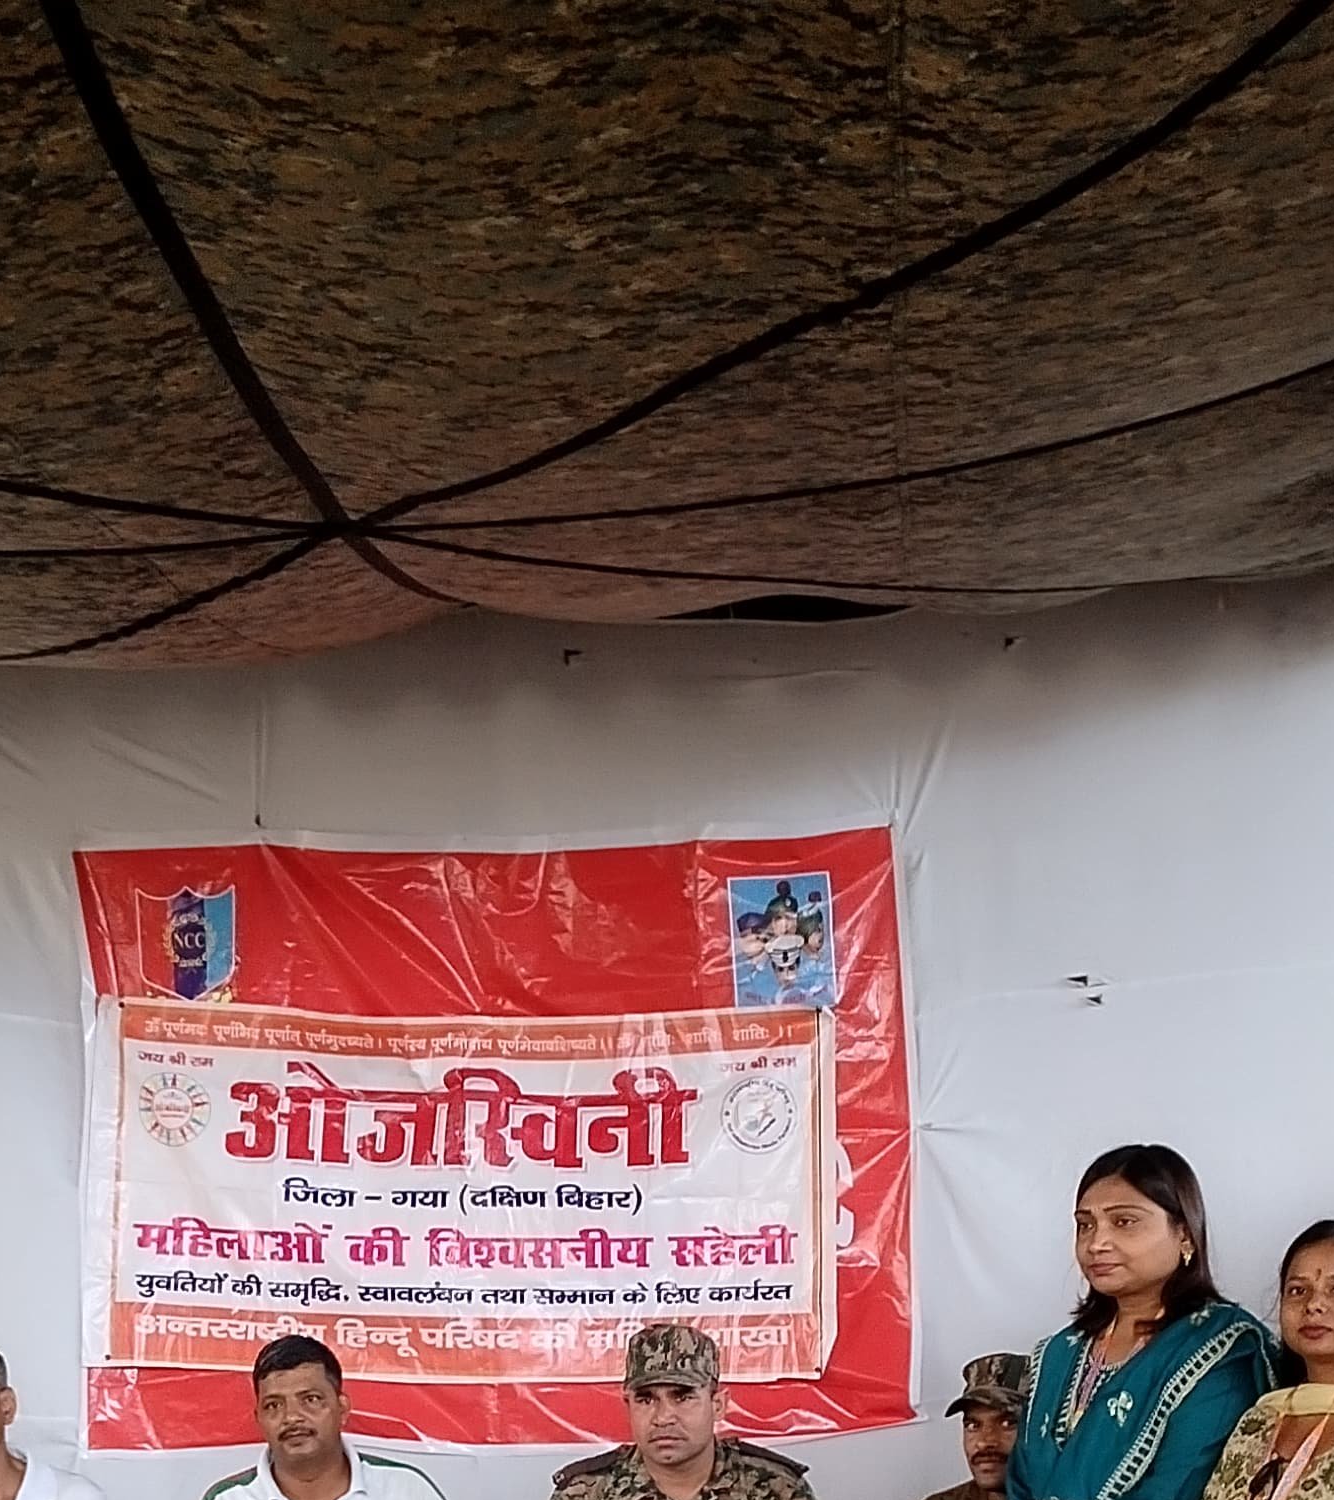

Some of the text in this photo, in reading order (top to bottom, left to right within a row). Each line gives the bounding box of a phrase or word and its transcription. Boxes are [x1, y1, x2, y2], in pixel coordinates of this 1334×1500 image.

[173, 932, 206, 949] NCC
[137, 1050, 214, 1068] जय श्री राम
[750, 1055, 768, 1069] श्री
[772, 1056, 797, 1068] राम
[224, 1060, 698, 1169] ओजस्विनी
[282, 1177, 358, 1208] जिला
[392, 1190, 450, 1208] गया
[459, 1183, 547, 1215] (दक्षिण
[133, 1217, 799, 1269] महिलाओं की विश्वसनीय सहेली
[135, 1270, 228, 1299] युवतियों
[232, 1274, 262, 1298] की
[357, 1280, 475, 1305] स्वावलंबन
[480, 1287, 528, 1305] तथा
[532, 1288, 616, 1305] सम्मान
[622, 1281, 651, 1305] के
[654, 1280, 701, 1305] लिए
[708, 1277, 794, 1302] कार्यरत
[335, 1318, 419, 1358] हिन्दू
[531, 1322, 578, 1350] की
